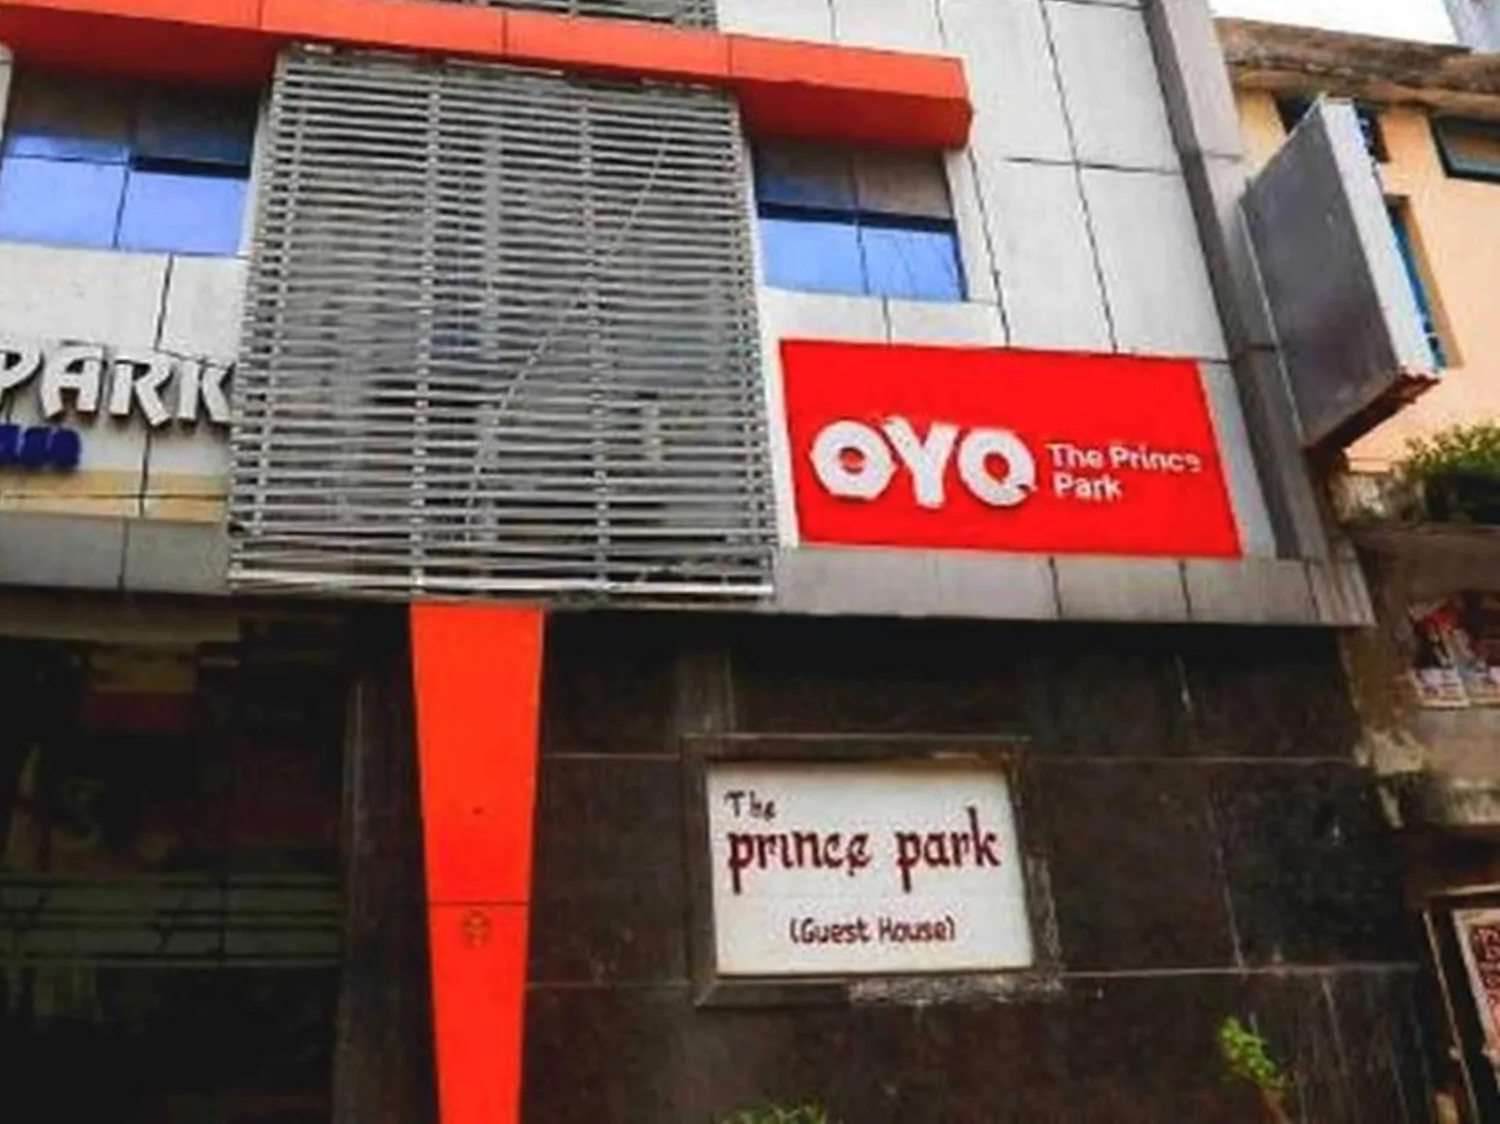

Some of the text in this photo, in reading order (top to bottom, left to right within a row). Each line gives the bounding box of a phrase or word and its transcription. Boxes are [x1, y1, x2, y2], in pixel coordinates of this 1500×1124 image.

[810, 416, 1038, 509] OYO
[1047, 443, 1202, 473] The Prince
[1054, 476, 1123, 501] Park
[726, 791, 777, 822] The
[728, 806, 1001, 895] prince park
[790, 915, 957, 944] (Guest House)
